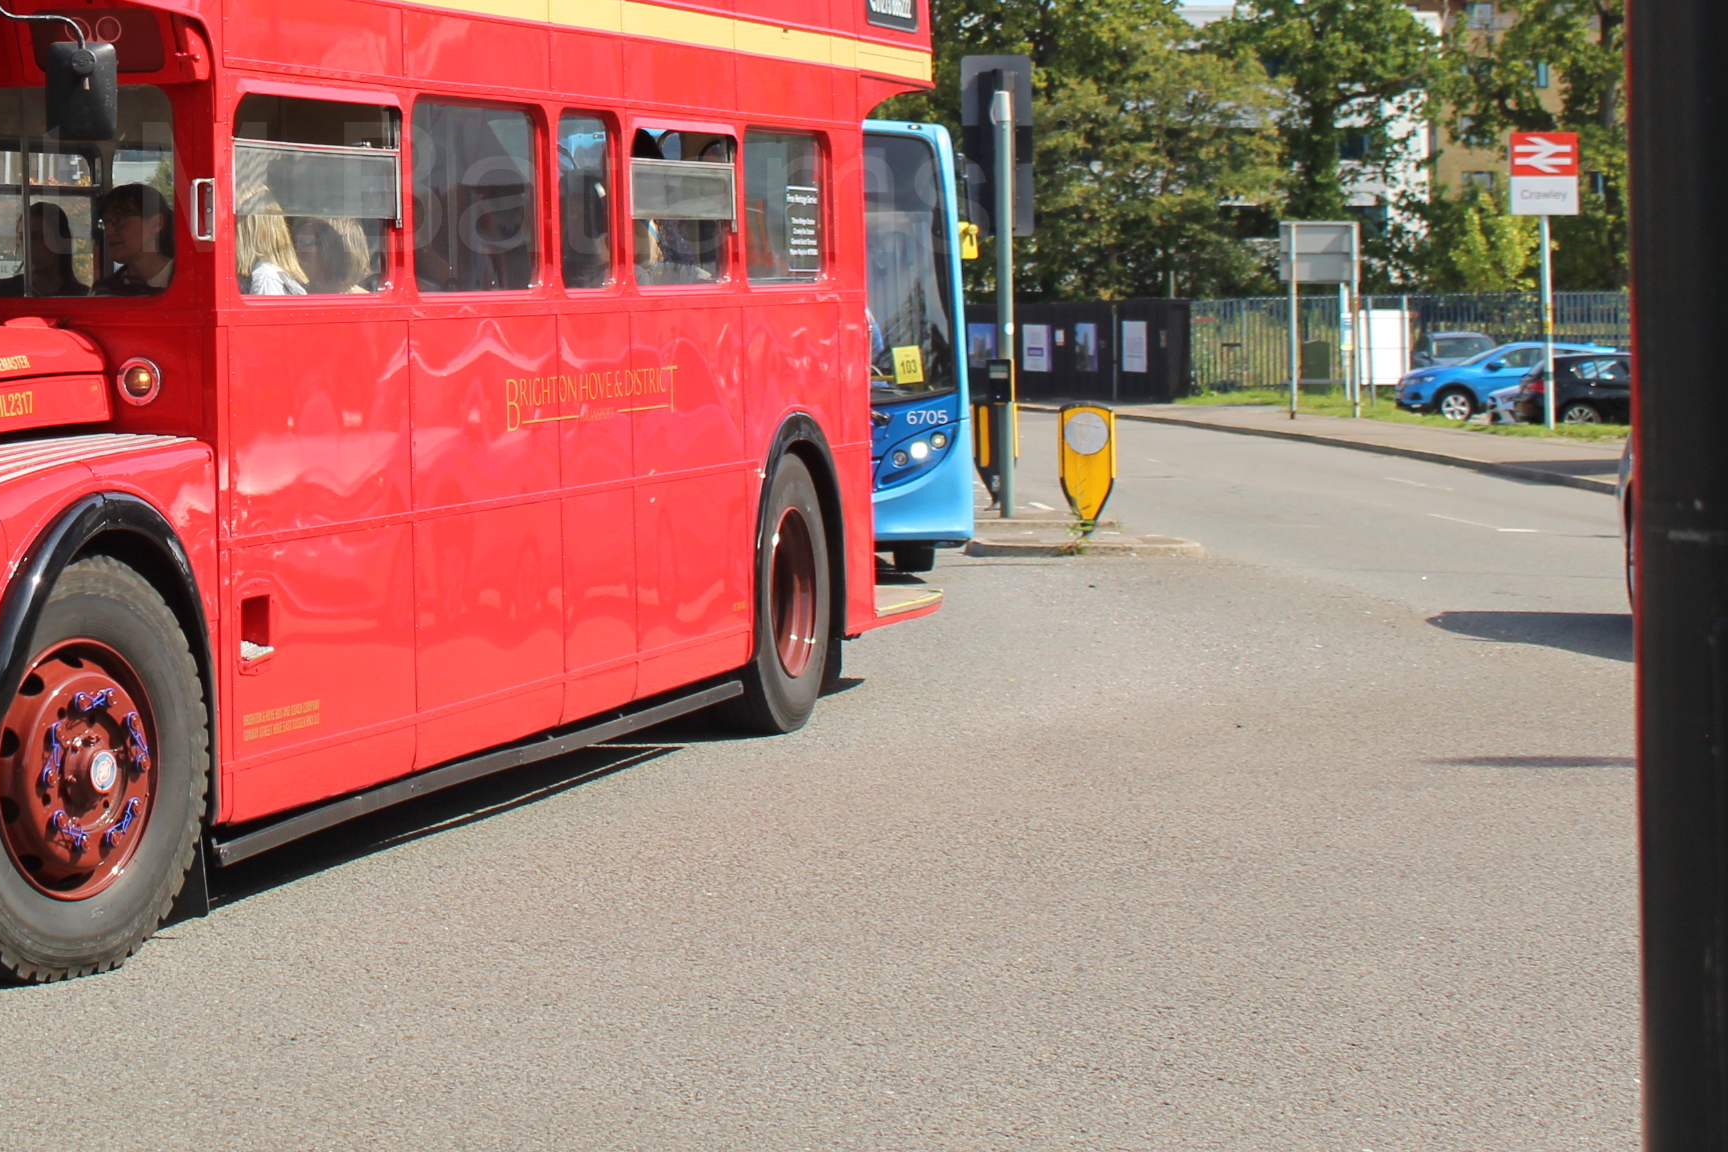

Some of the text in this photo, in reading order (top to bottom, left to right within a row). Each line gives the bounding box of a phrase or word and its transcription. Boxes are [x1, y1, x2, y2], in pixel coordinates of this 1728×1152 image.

[1520, 189, 1568, 202] Crawley
[900, 359, 918, 374] 103
[505, 365, 678, 432] BRIGHTON HOVE & DISTRICT
[906, 410, 948, 425] 6705
